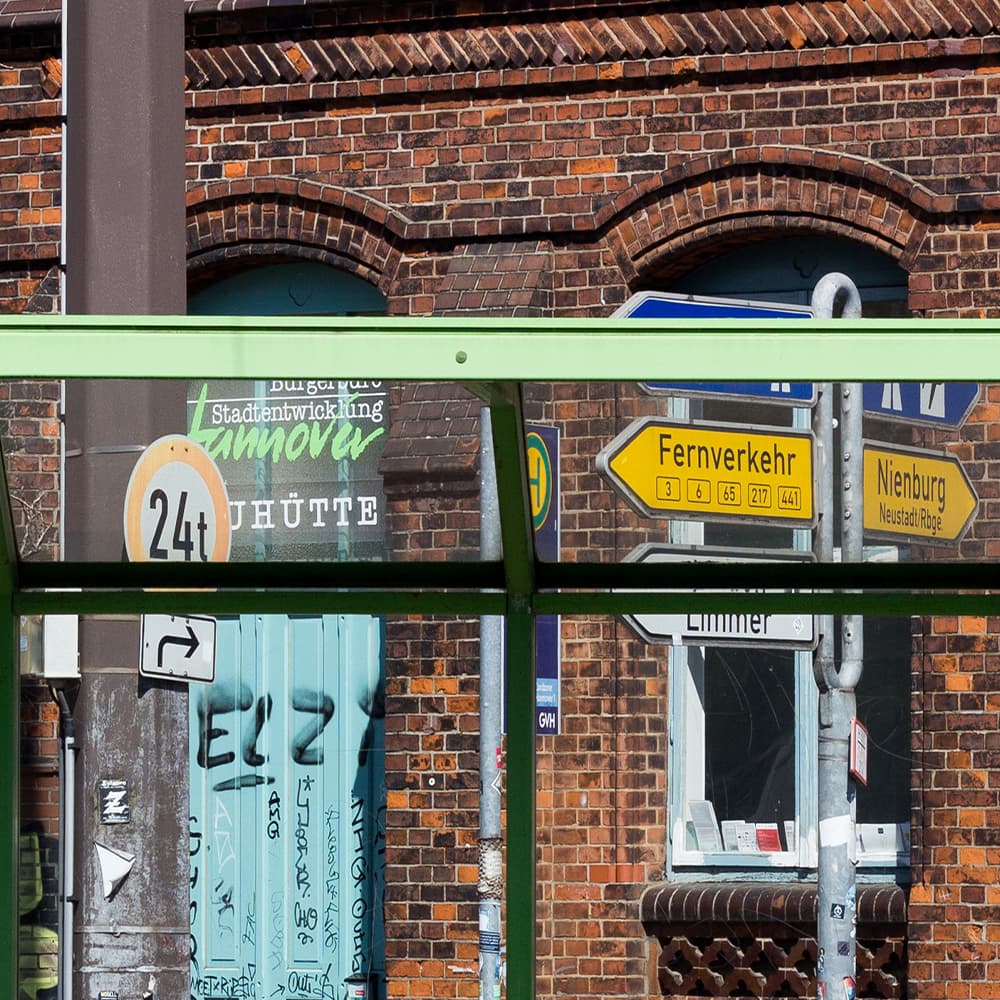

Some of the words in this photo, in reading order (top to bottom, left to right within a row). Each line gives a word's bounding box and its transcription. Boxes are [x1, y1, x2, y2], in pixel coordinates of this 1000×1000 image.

[212, 400, 384, 424] Stadtentwicklung
[659, 433, 796, 475] Fernverkehr
[665, 481, 672, 497] 3
[696, 484, 702, 499] 6
[723, 486, 736, 502] 65
[751, 488, 769, 504] 217
[781, 491, 799, 507] 441
[877, 458, 946, 513] Nienburg
[879, 502, 943, 535] Neustadt/Rbge.
[538, 711, 556, 729] GVH
